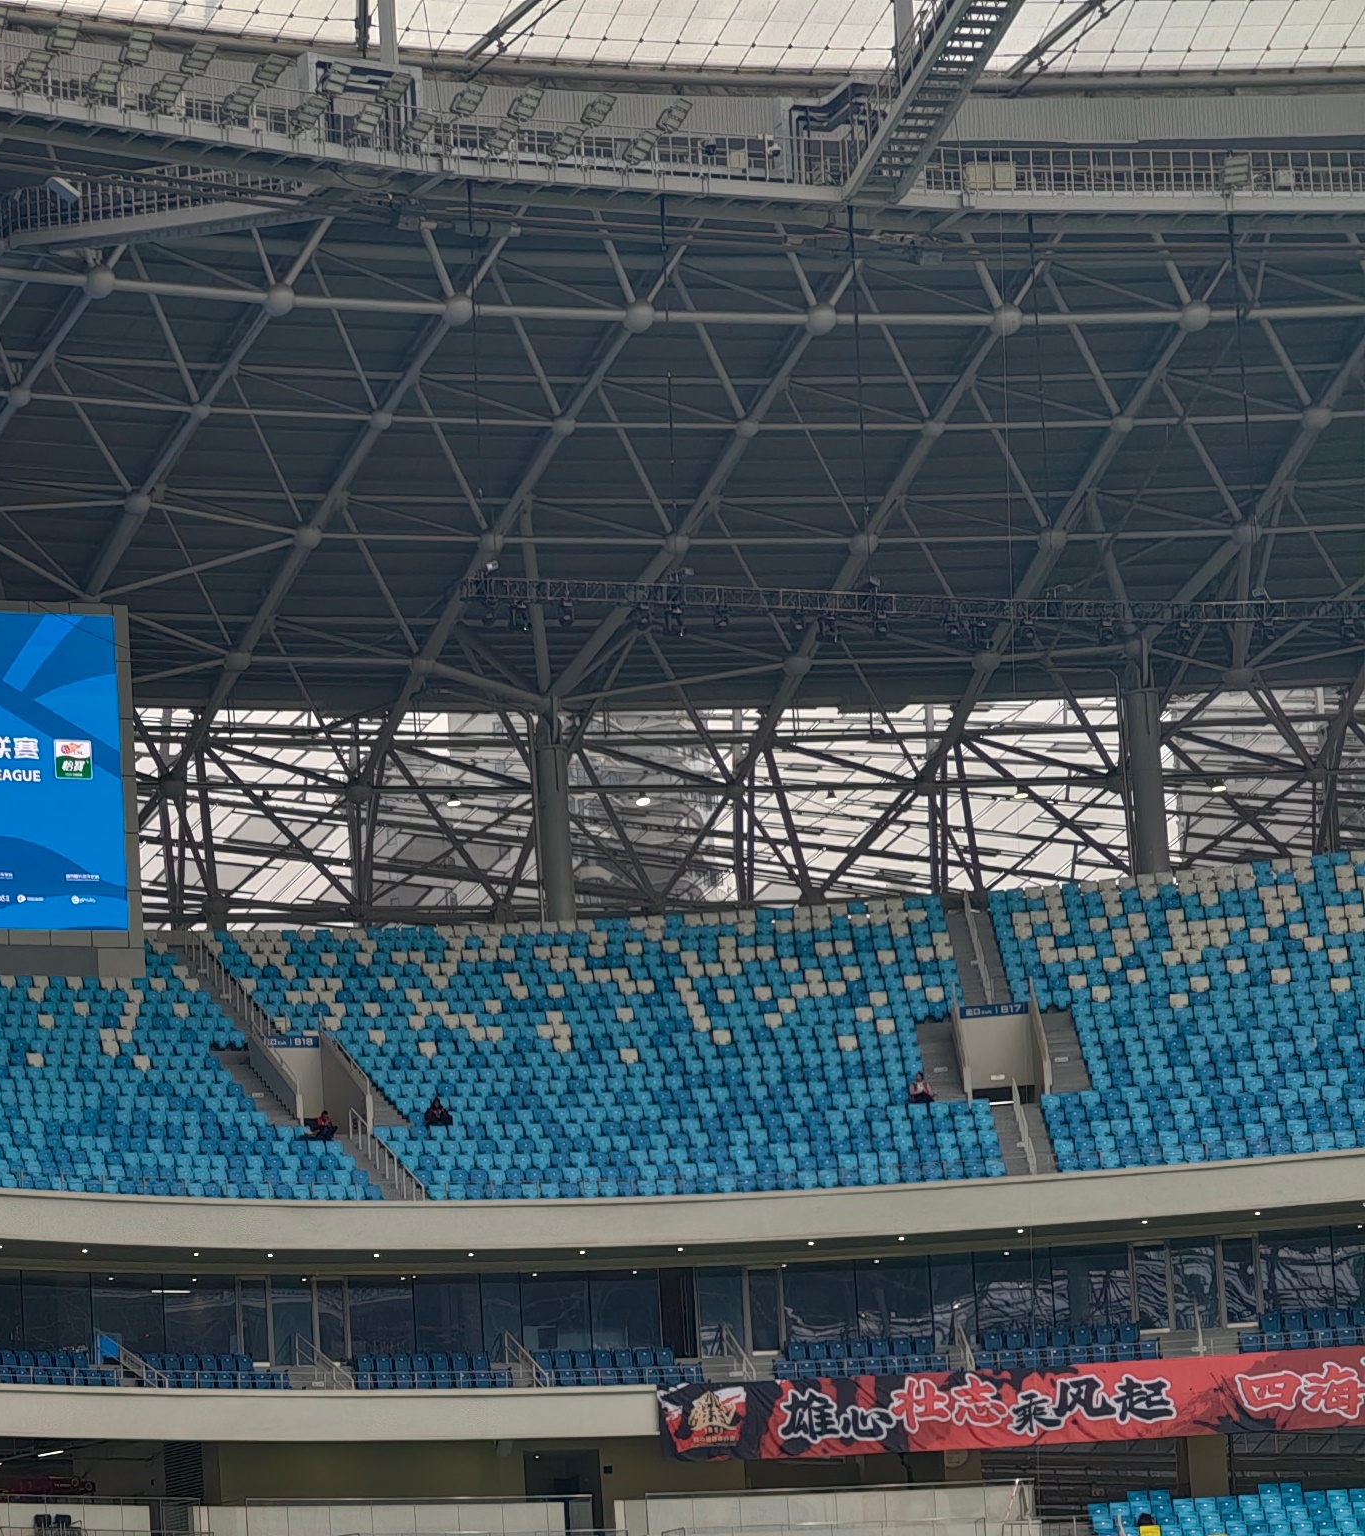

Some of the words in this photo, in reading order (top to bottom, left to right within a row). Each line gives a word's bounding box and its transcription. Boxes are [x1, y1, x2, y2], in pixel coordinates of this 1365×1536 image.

[777, 1370, 1178, 1444] 雄心壮志乘风起
[1235, 1361, 1365, 1420] 四海
